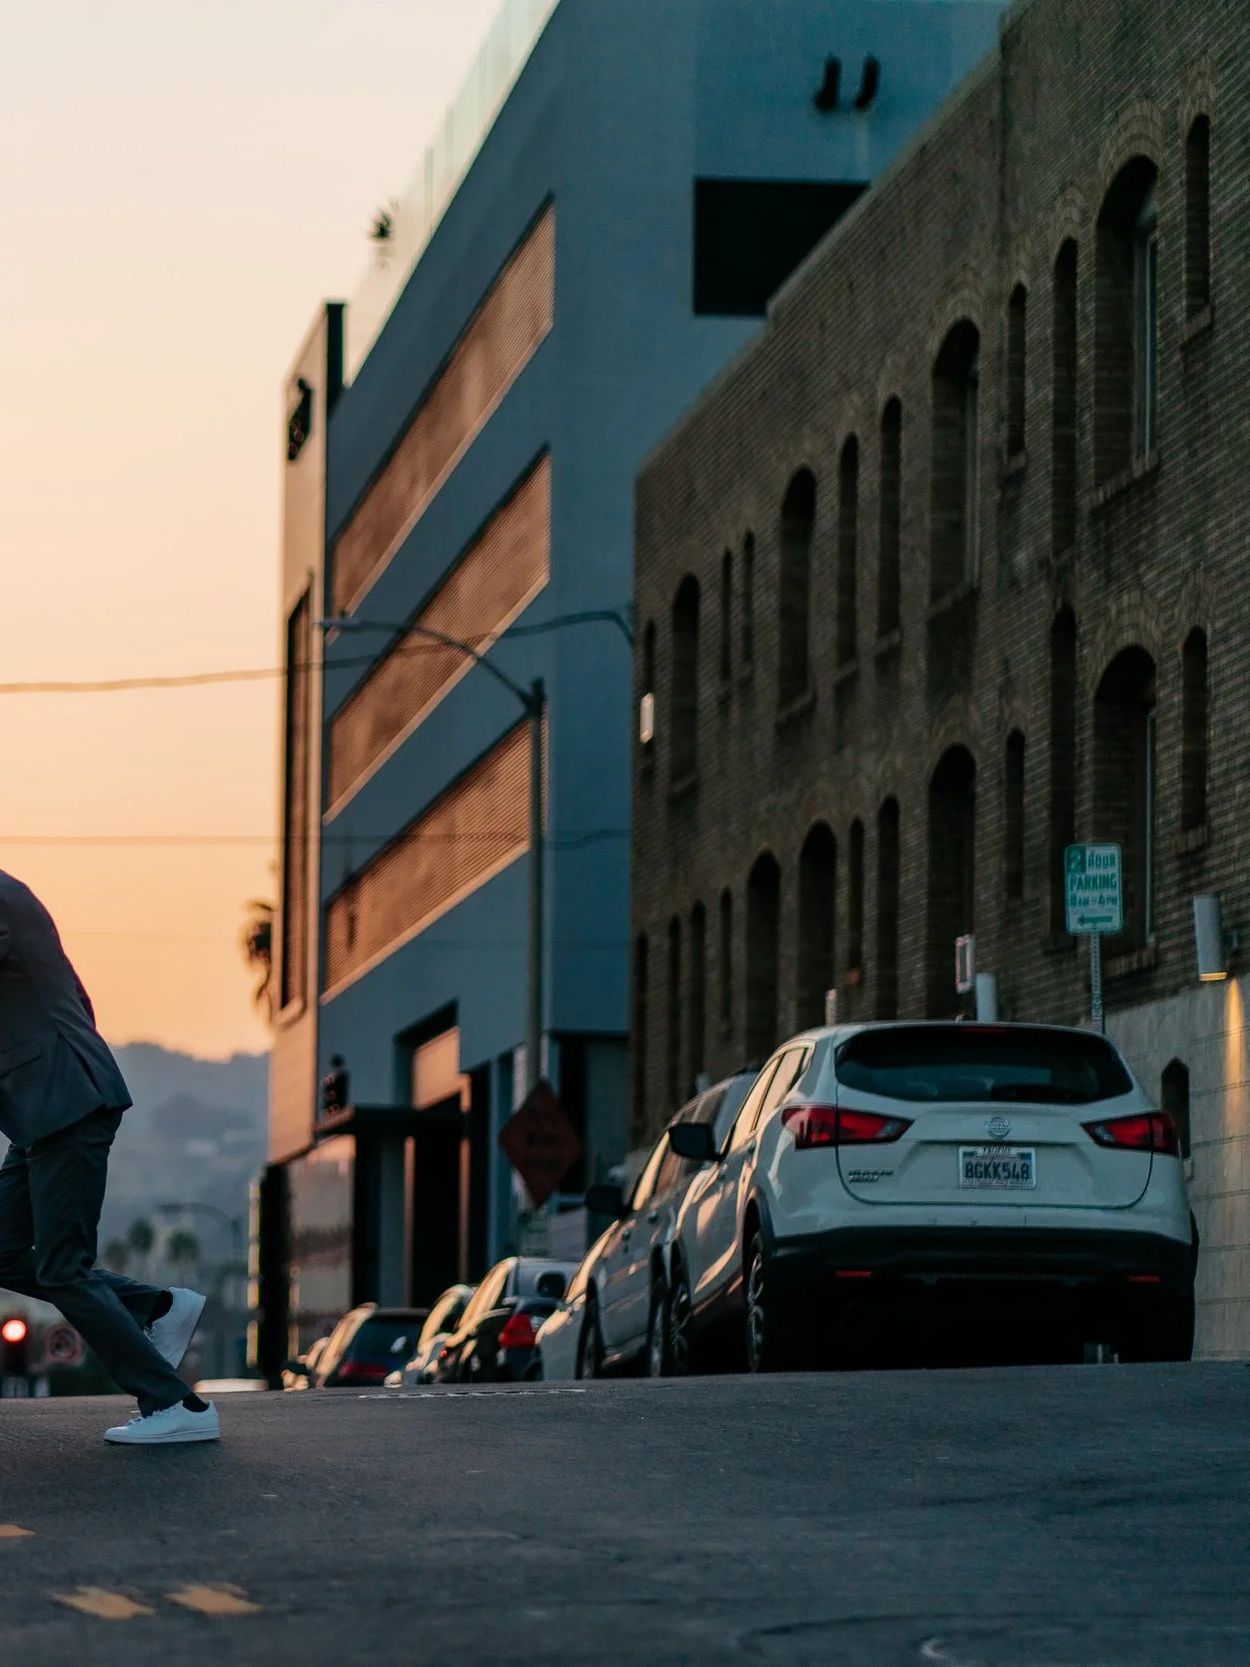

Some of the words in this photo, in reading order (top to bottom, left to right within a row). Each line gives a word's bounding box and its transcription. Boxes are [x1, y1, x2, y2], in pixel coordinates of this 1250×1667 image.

[1070, 848, 1082, 873] 2
[1088, 853, 1117, 869] HOUR
[1069, 873, 1117, 891] PARKING
